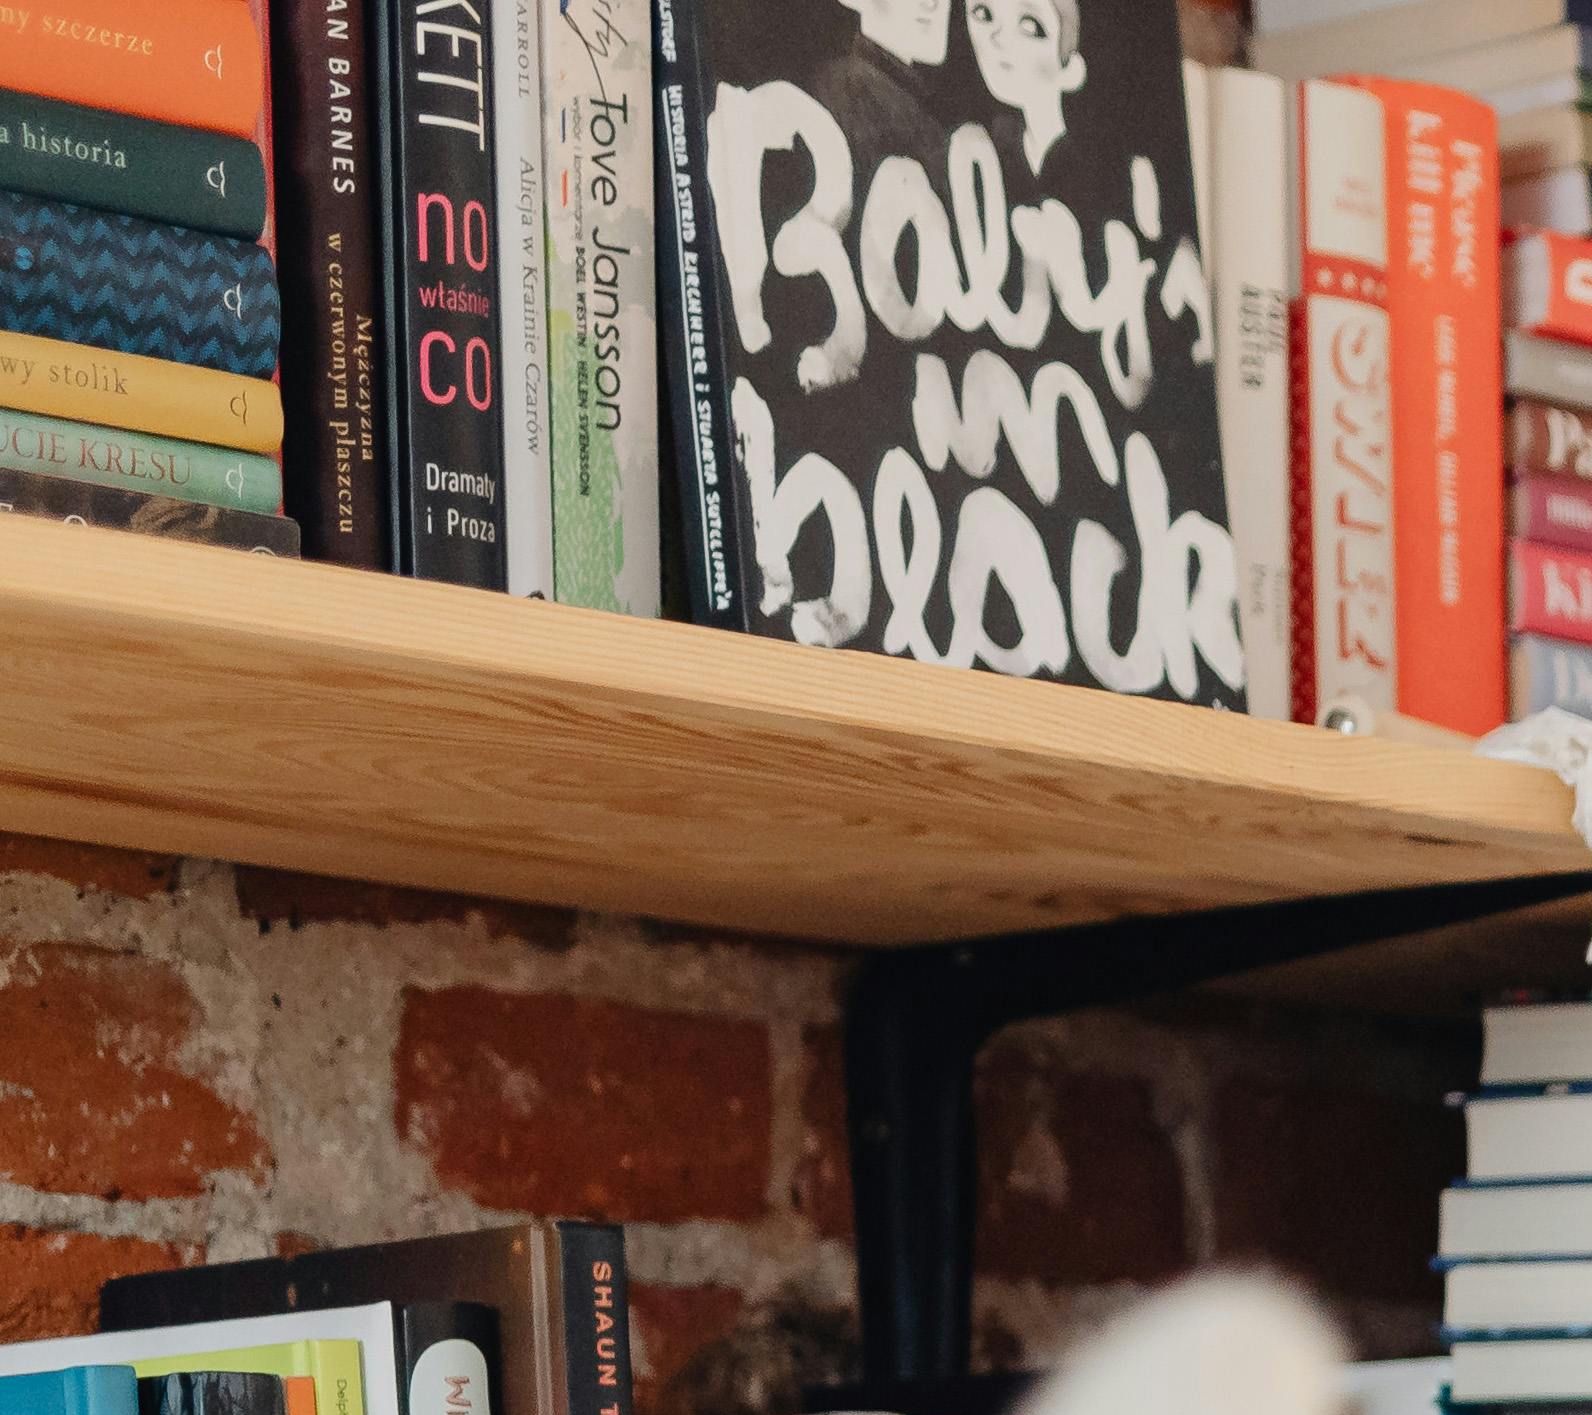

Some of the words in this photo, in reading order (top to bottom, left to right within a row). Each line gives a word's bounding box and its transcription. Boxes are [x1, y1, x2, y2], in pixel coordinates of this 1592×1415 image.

[43, 14, 153, 56] szczerze
[516, 4, 530, 98] ARROLL
[22, 122, 128, 169] historia
[328, 57, 355, 194] BARNES
[589, 93, 629, 207] Tove
[668, 84, 689, 167] HISTORIA
[417, 192, 489, 272] no
[516, 156, 535, 227] Alicja
[675, 173, 697, 243] ASTRID
[327, 231, 342, 252] w
[521, 236, 534, 257] w
[327, 262, 349, 409] czerwonym
[522, 265, 540, 355] Krainie
[592, 226, 631, 432] Jansson
[49, 363, 128, 395] stolik
[353, 314, 375, 461] Mężczyzna
[524, 362, 542, 455] Czarów
[577, 360, 590, 407] HELEN
[79, 437, 193, 485] KRESU
[698, 399, 719, 486] STUARTA
[912, 349, 1119, 507] in
[329, 421, 356, 533] płaszczu
[426, 462, 496, 504] Dramaty
[426, 507, 433, 534] i
[447, 508, 496, 543] Proza
[731, 377, 1247, 701] black
[591, 1260, 618, 1387] SHAUN
